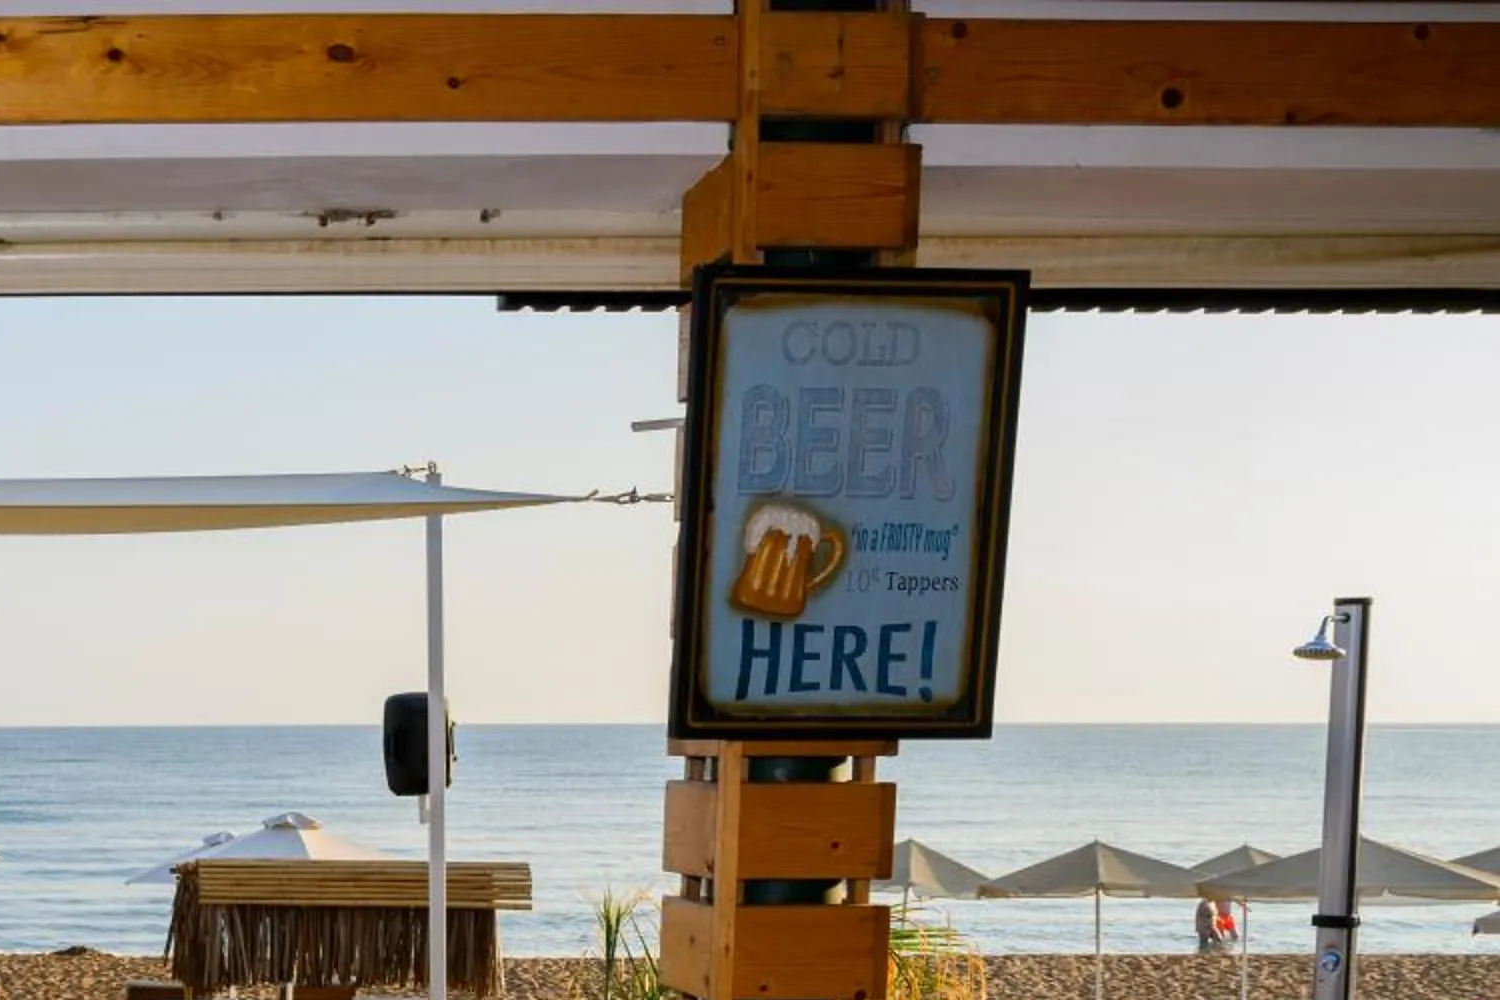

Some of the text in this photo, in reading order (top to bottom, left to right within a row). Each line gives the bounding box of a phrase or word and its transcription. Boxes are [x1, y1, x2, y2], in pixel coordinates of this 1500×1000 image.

[782, 320, 921, 366] COLD
[737, 384, 955, 500] BEER
[870, 529, 879, 552] a
[880, 521, 924, 553] FROSTY
[886, 571, 960, 596] Tappers
[735, 618, 938, 703] HERE!
